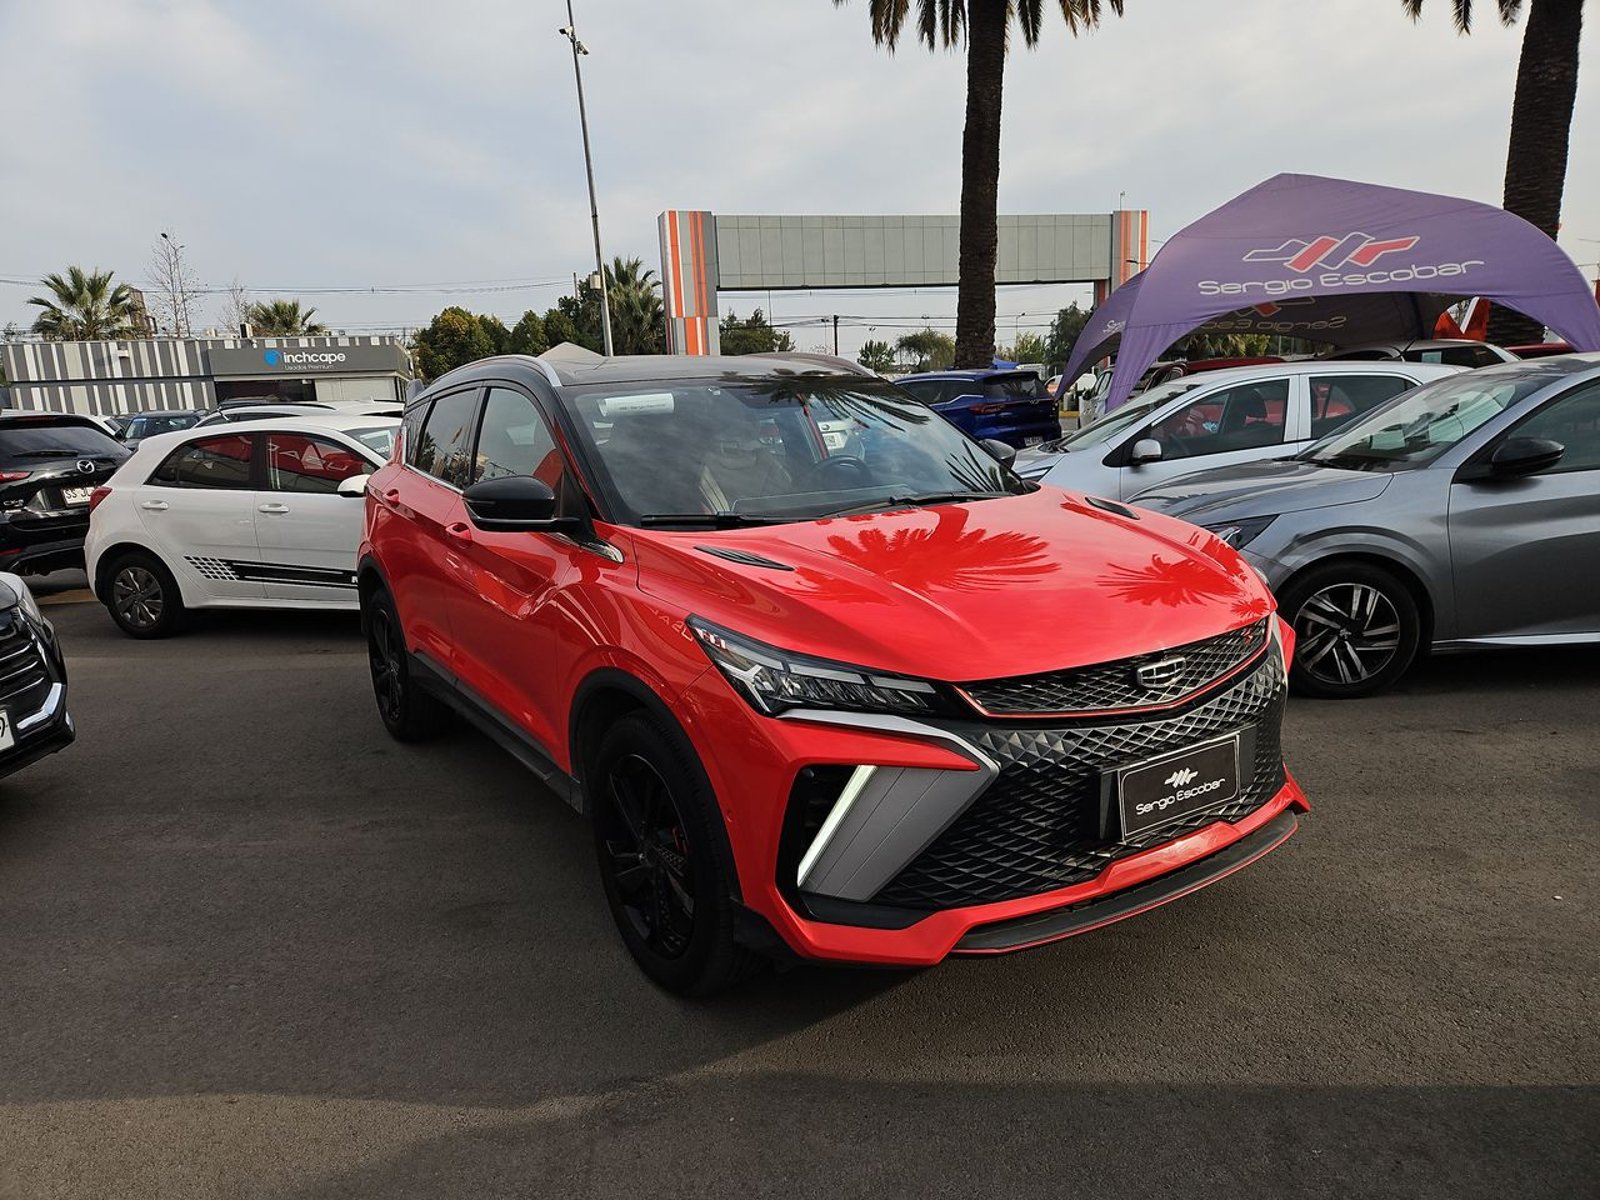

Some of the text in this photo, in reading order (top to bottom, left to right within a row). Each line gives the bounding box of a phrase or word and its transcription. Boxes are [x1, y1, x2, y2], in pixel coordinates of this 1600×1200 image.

[1198, 260, 1485, 295] Sergio Escobar
[283, 351, 346, 364] inchcape
[1176, 778, 1225, 801] Escobar
